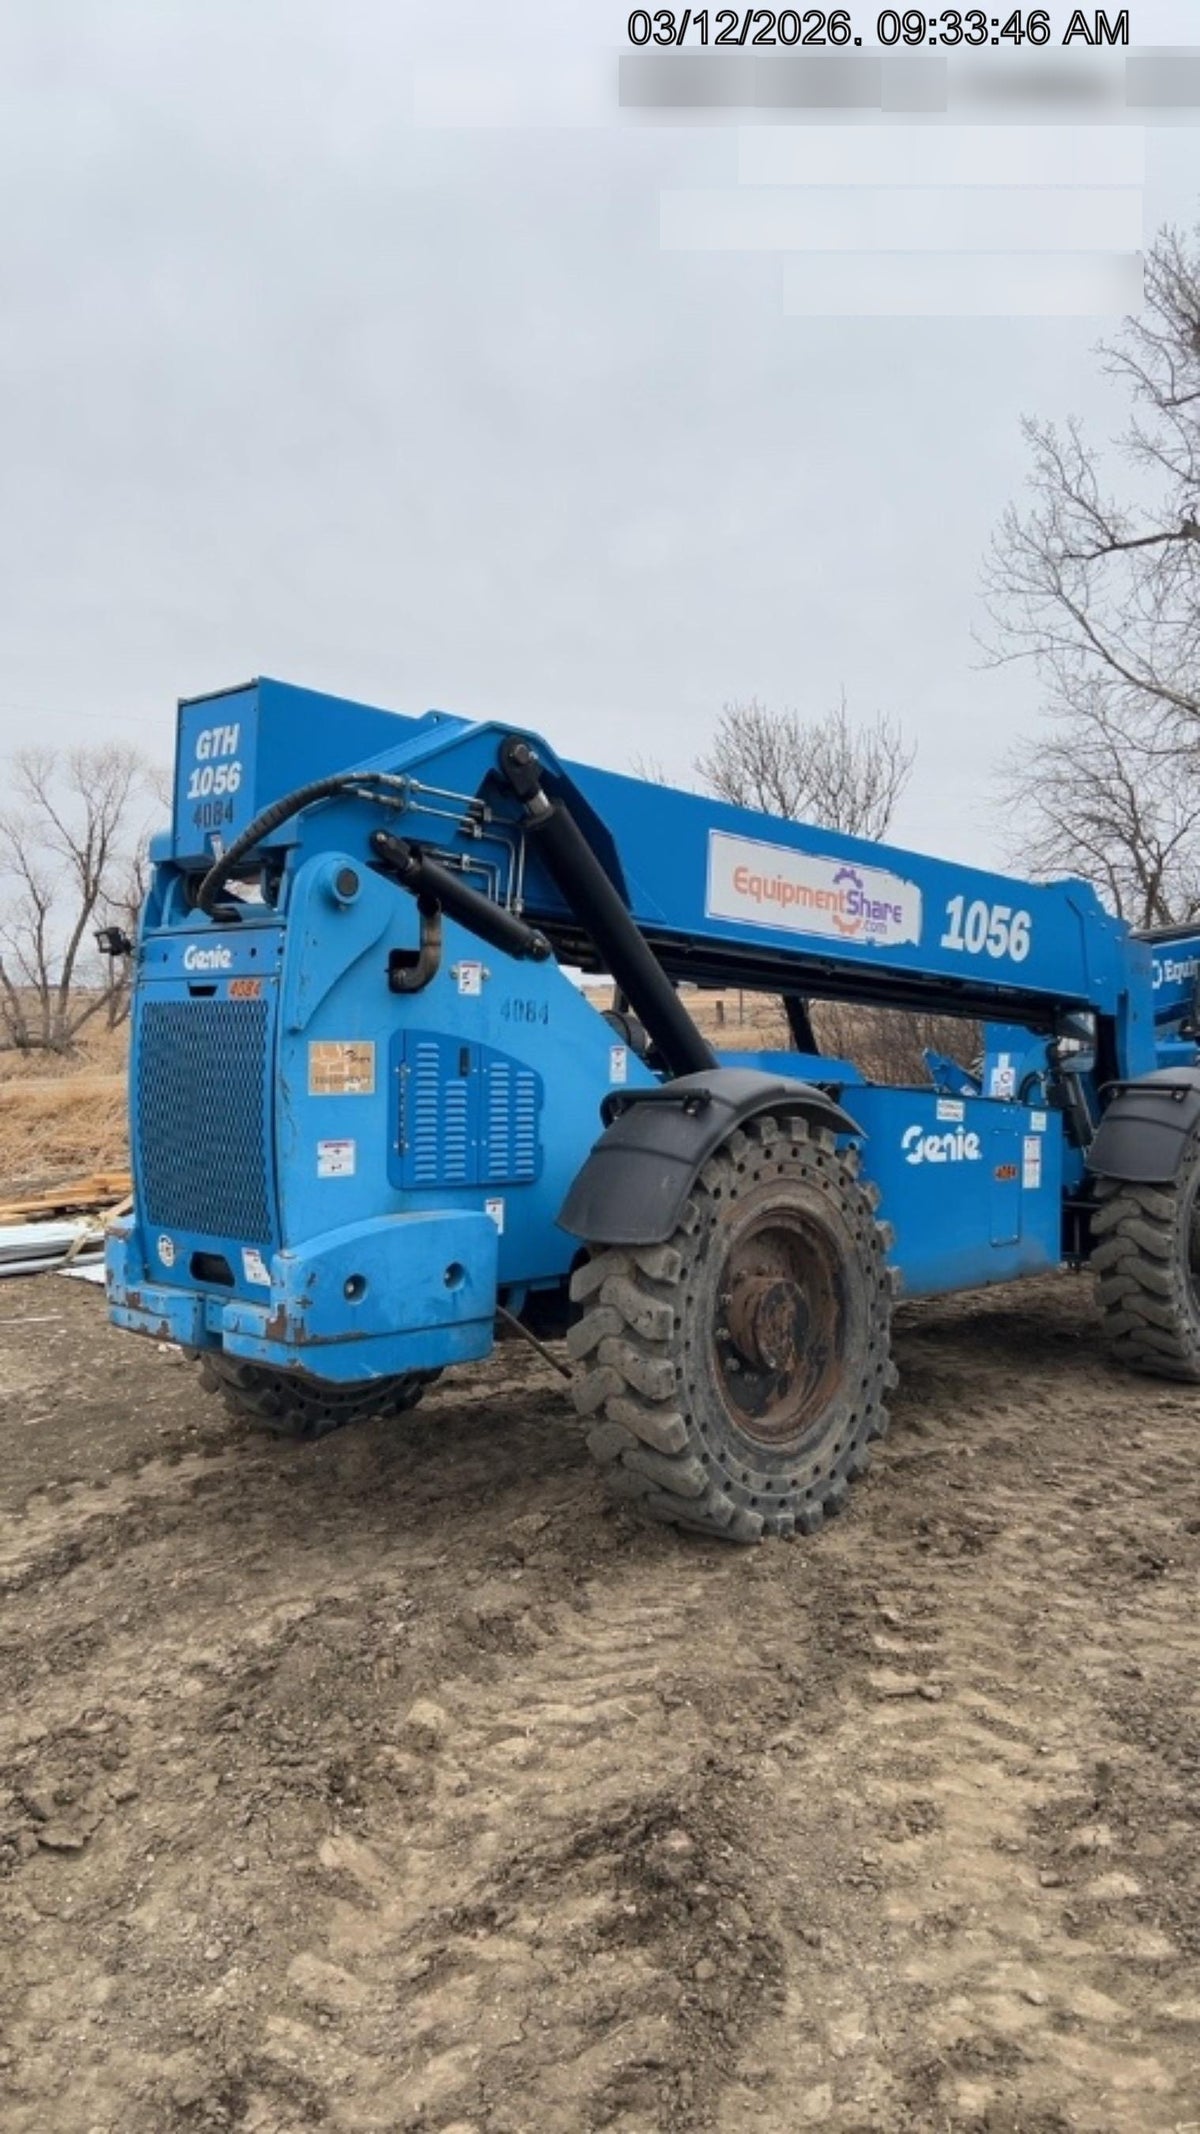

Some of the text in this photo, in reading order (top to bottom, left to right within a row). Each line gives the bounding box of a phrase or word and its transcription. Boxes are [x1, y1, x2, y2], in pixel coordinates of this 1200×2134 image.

[196, 722, 240, 761] GTH
[187, 760, 242, 799] 1056
[192, 798, 234, 831] 4084
[733, 866, 903, 924] EquipmentShare
[940, 894, 1032, 963] 1056
[184, 944, 232, 971] Genie
[901, 1124, 982, 1166] Genie
